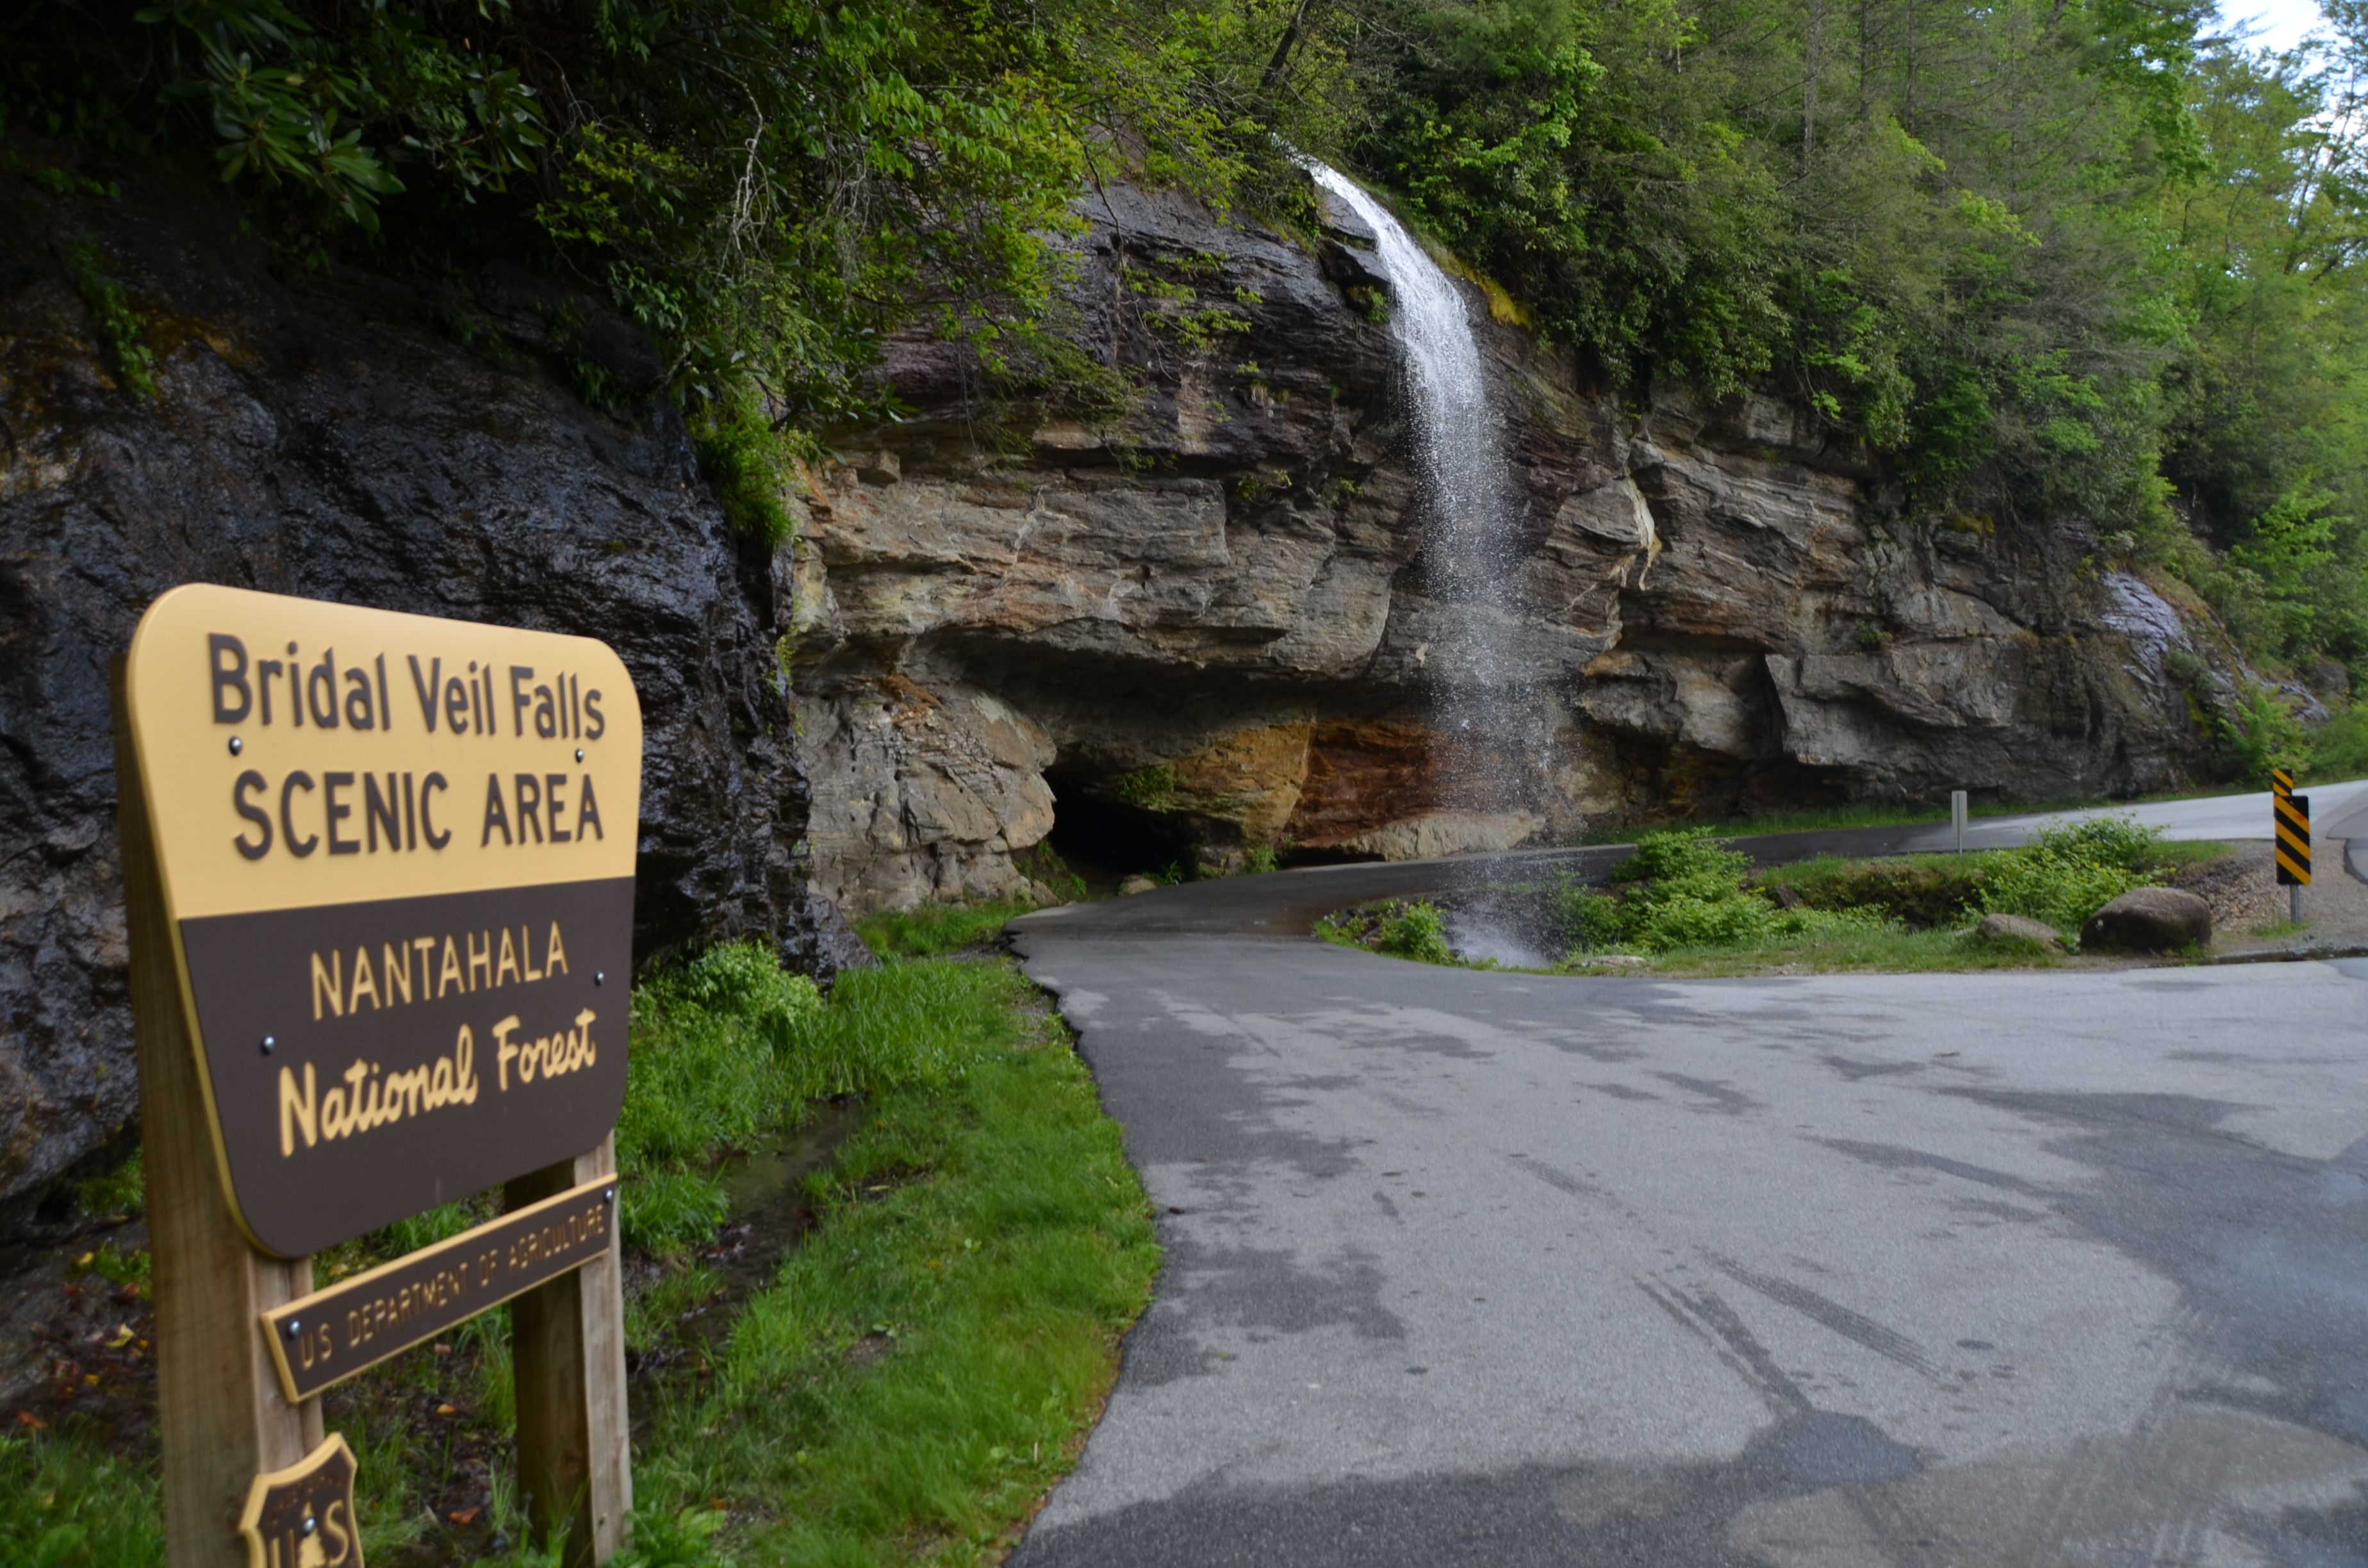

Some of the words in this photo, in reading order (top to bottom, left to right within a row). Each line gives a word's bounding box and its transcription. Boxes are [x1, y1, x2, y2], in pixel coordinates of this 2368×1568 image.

[207, 632, 390, 731] Bridal
[408, 654, 497, 735] Veil
[509, 665, 605, 740] Falls
[233, 769, 452, 861] SCENIC
[481, 772, 604, 848] AREA
[311, 920, 569, 1020] NANTAHALA
[278, 1024, 478, 1157] National
[492, 1007, 596, 1091] Forest
[300, 1322, 333, 1371] US
[347, 1262, 468, 1349] DEPARTMENT
[479, 1248, 498, 1287] OF
[509, 1204, 604, 1272] AGRICULTURE
